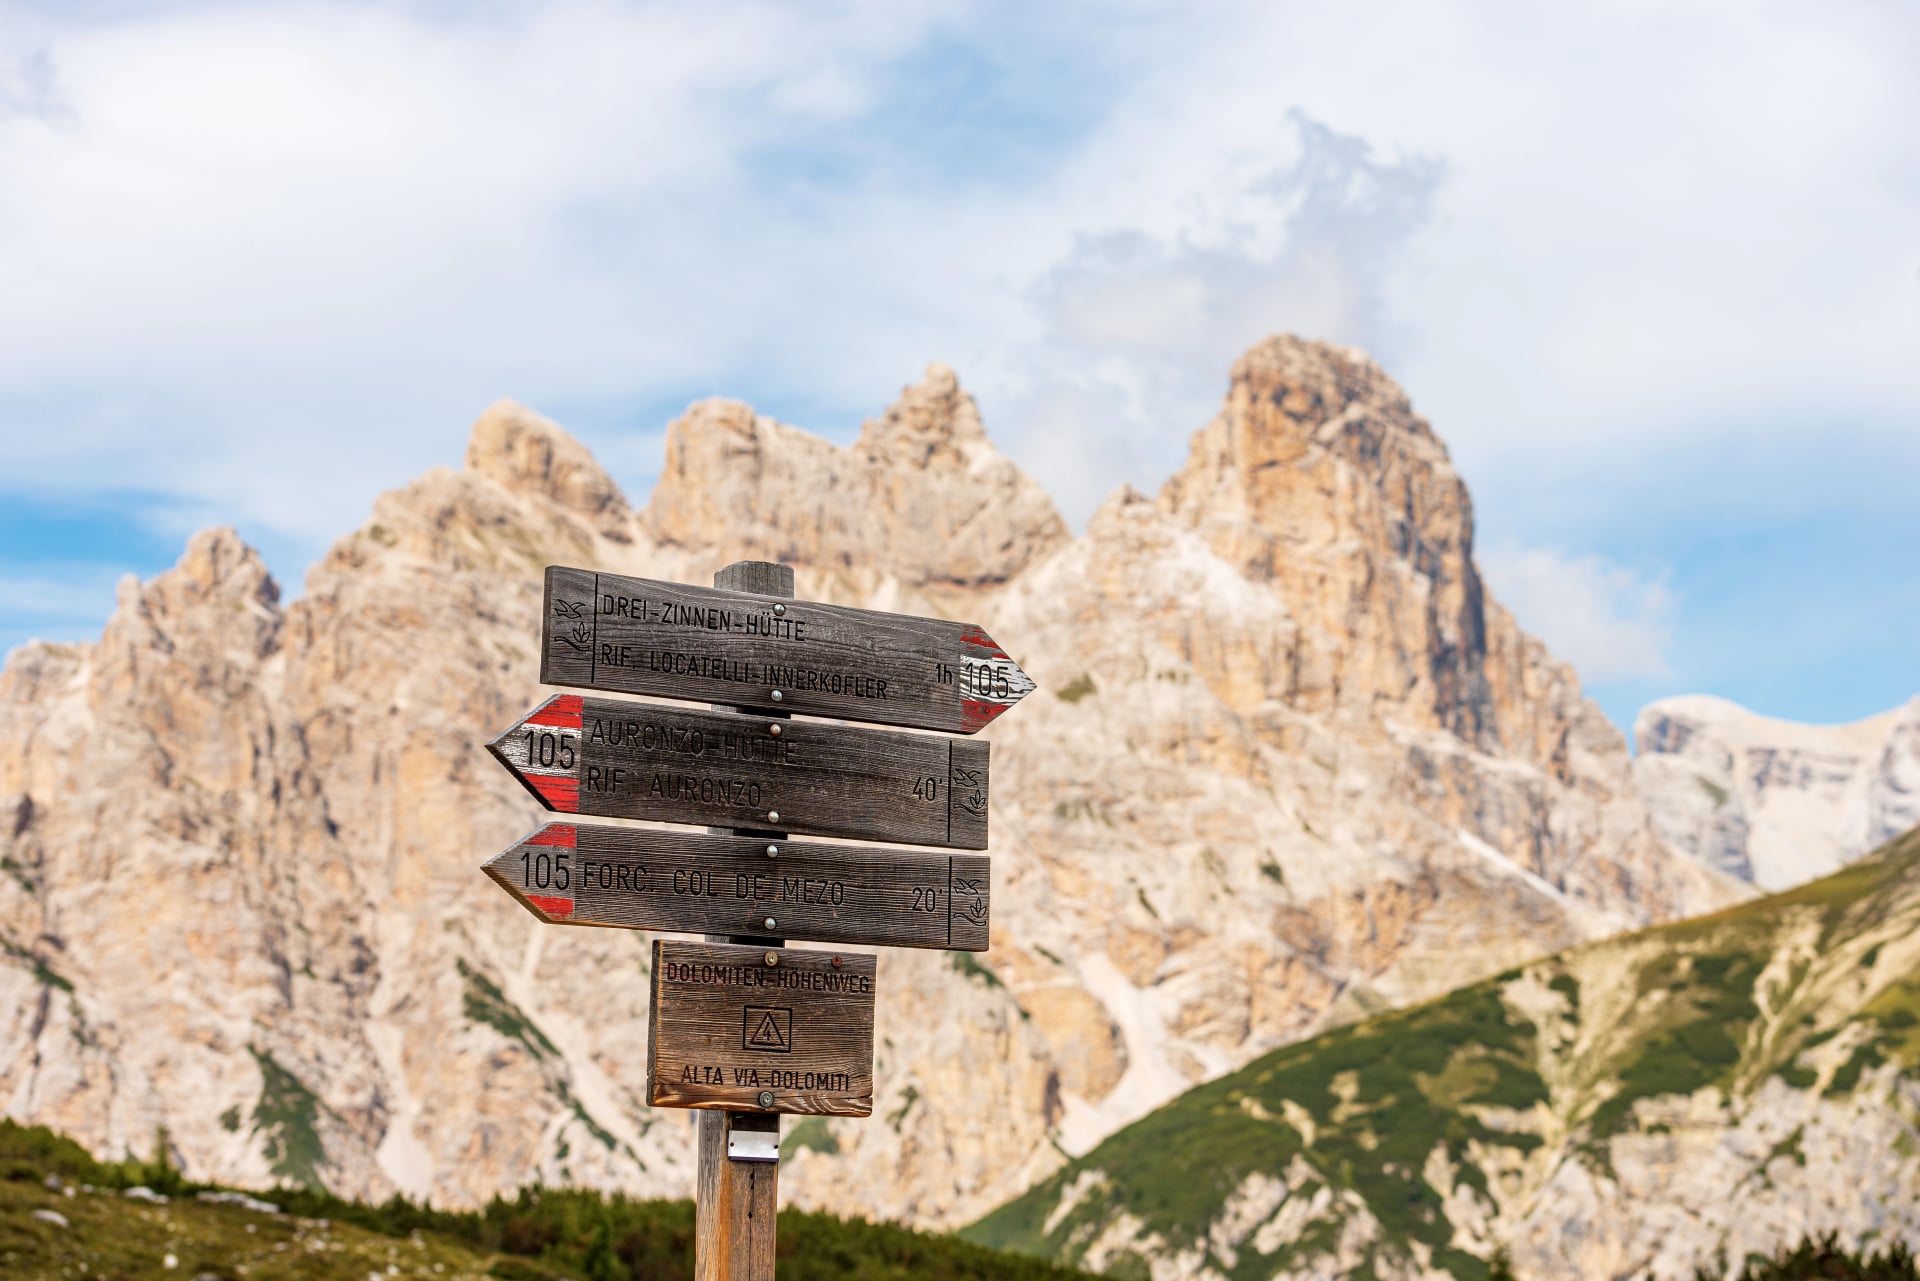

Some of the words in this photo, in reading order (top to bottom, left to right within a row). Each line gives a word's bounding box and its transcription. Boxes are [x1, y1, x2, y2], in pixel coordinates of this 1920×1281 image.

[603, 594, 805, 641] DREI-ZINNEN-HÜTTE
[601, 643, 636, 669] RIF.
[650, 650, 887, 699] LOCATELLI-INNERKOFLER
[935, 663, 953, 685] 1h
[965, 662, 1009, 698] 105
[524, 730, 575, 770] 105
[587, 766, 632, 796] RIF.
[650, 773, 761, 809] AURONZO
[521, 852, 570, 890] 105
[583, 862, 655, 893] FORC.
[673, 869, 718, 897] COL
[735, 873, 768, 901] DE
[782, 877, 844, 906] MEZO
[763, 1022, 771, 1041] 4
[681, 1065, 724, 1085] ALTA
